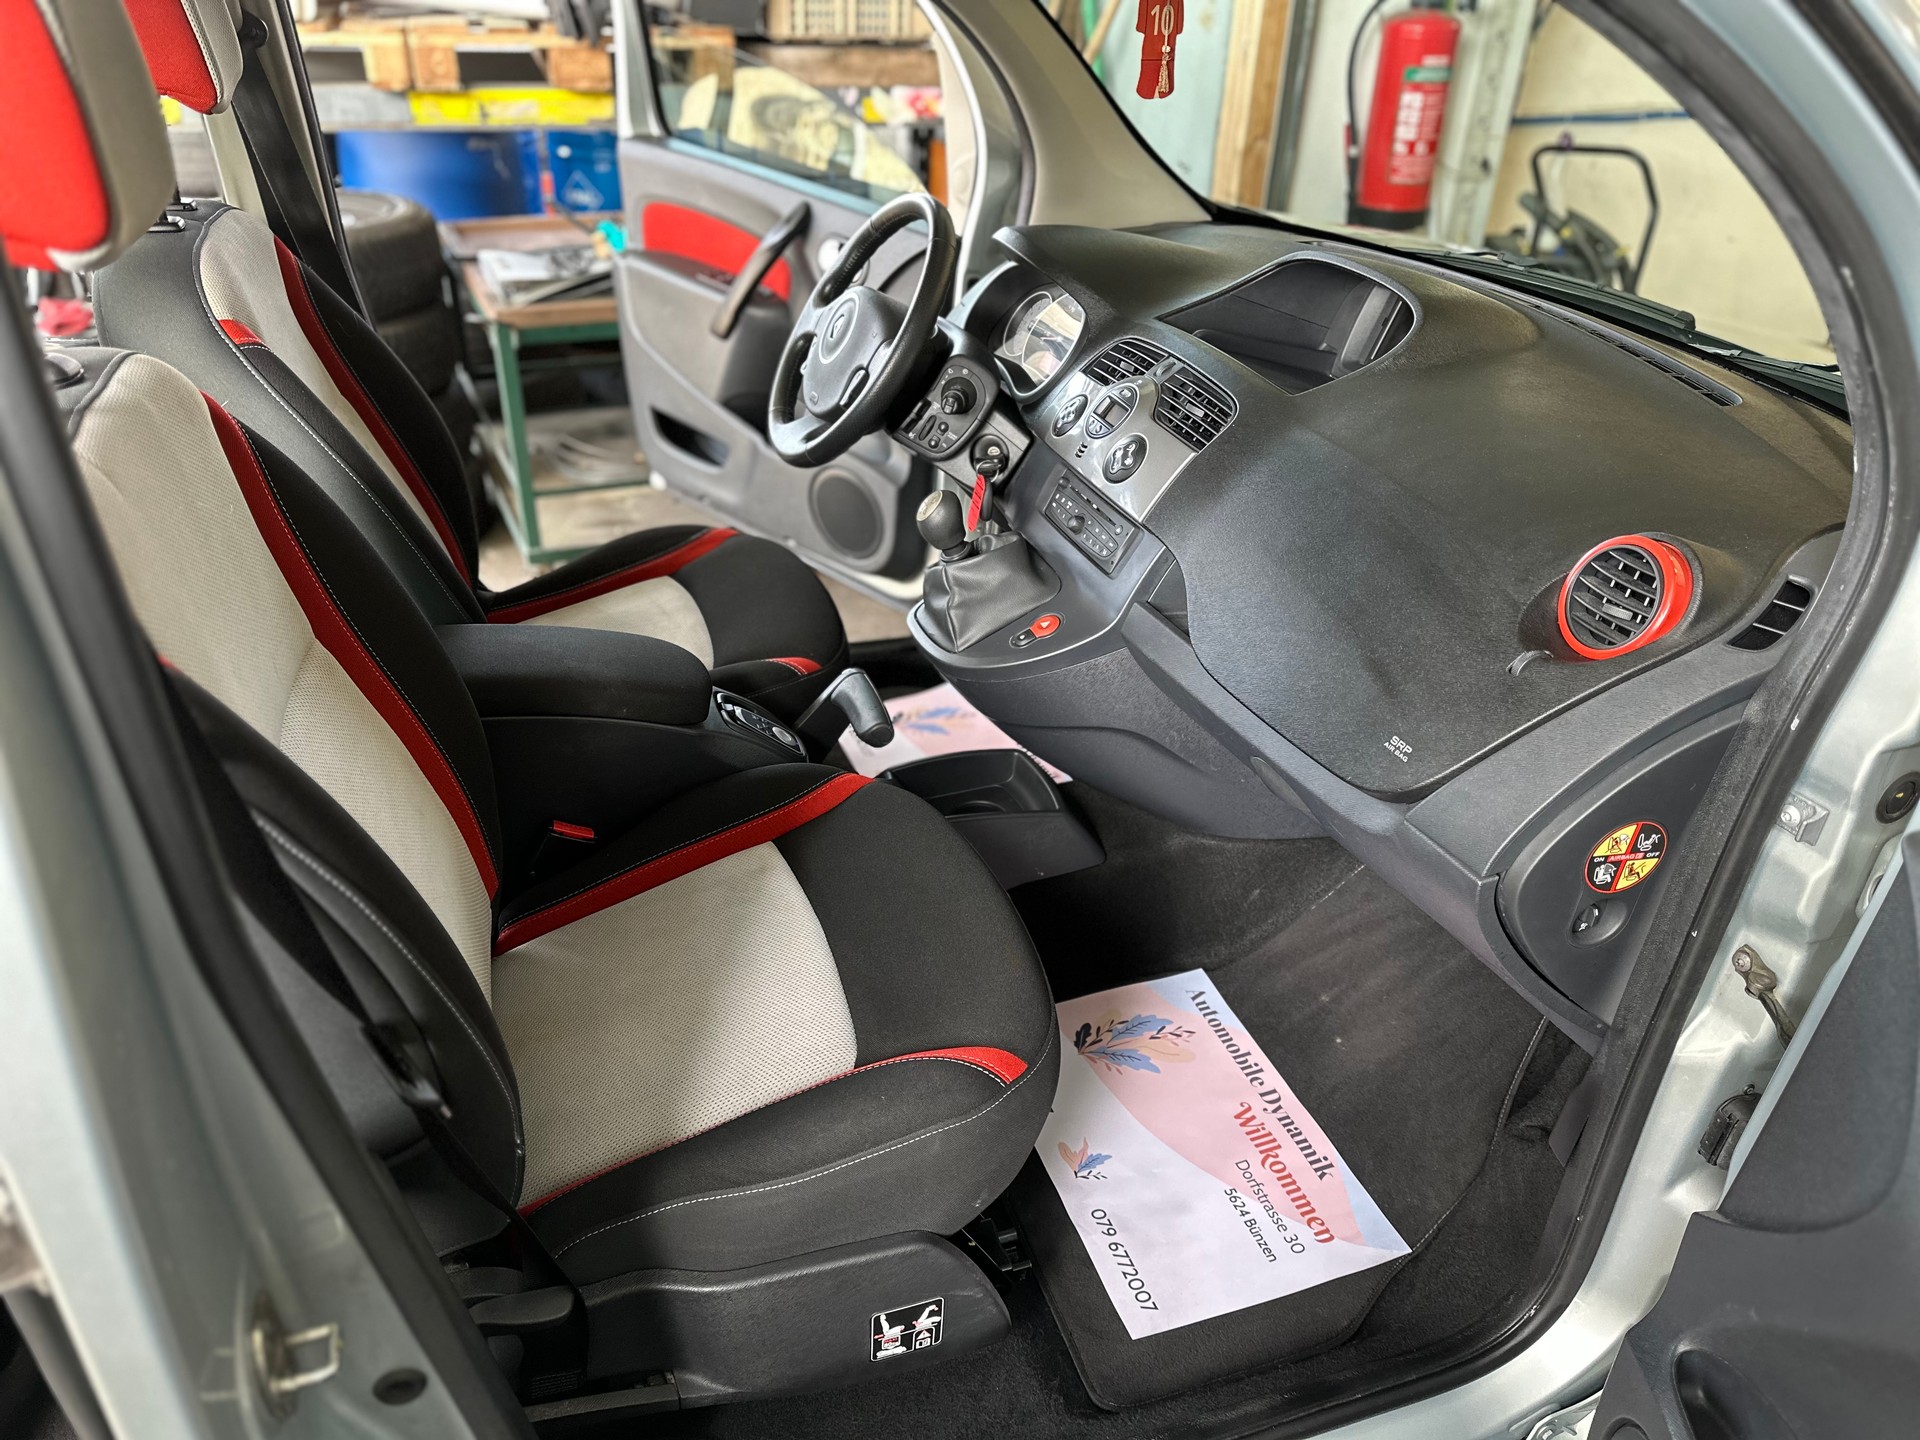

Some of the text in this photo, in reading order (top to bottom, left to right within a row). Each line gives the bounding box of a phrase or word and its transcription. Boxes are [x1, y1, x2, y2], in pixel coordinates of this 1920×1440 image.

[1150, 4, 1175, 36] 10
[1383, 742, 1408, 762] AIR BAG
[1390, 735, 1413, 754] SRP
[1609, 853, 1635, 861] AIRBAG
[1185, 990, 1336, 1181] Automobile Dynamik
[1233, 1101, 1336, 1244] Willkommen
[1235, 1159, 1306, 1254] Dorfstrasse 30
[1091, 1208, 1159, 1311] 079 6772007
[1224, 1187, 1278, 1263] 5624 Bünzen
